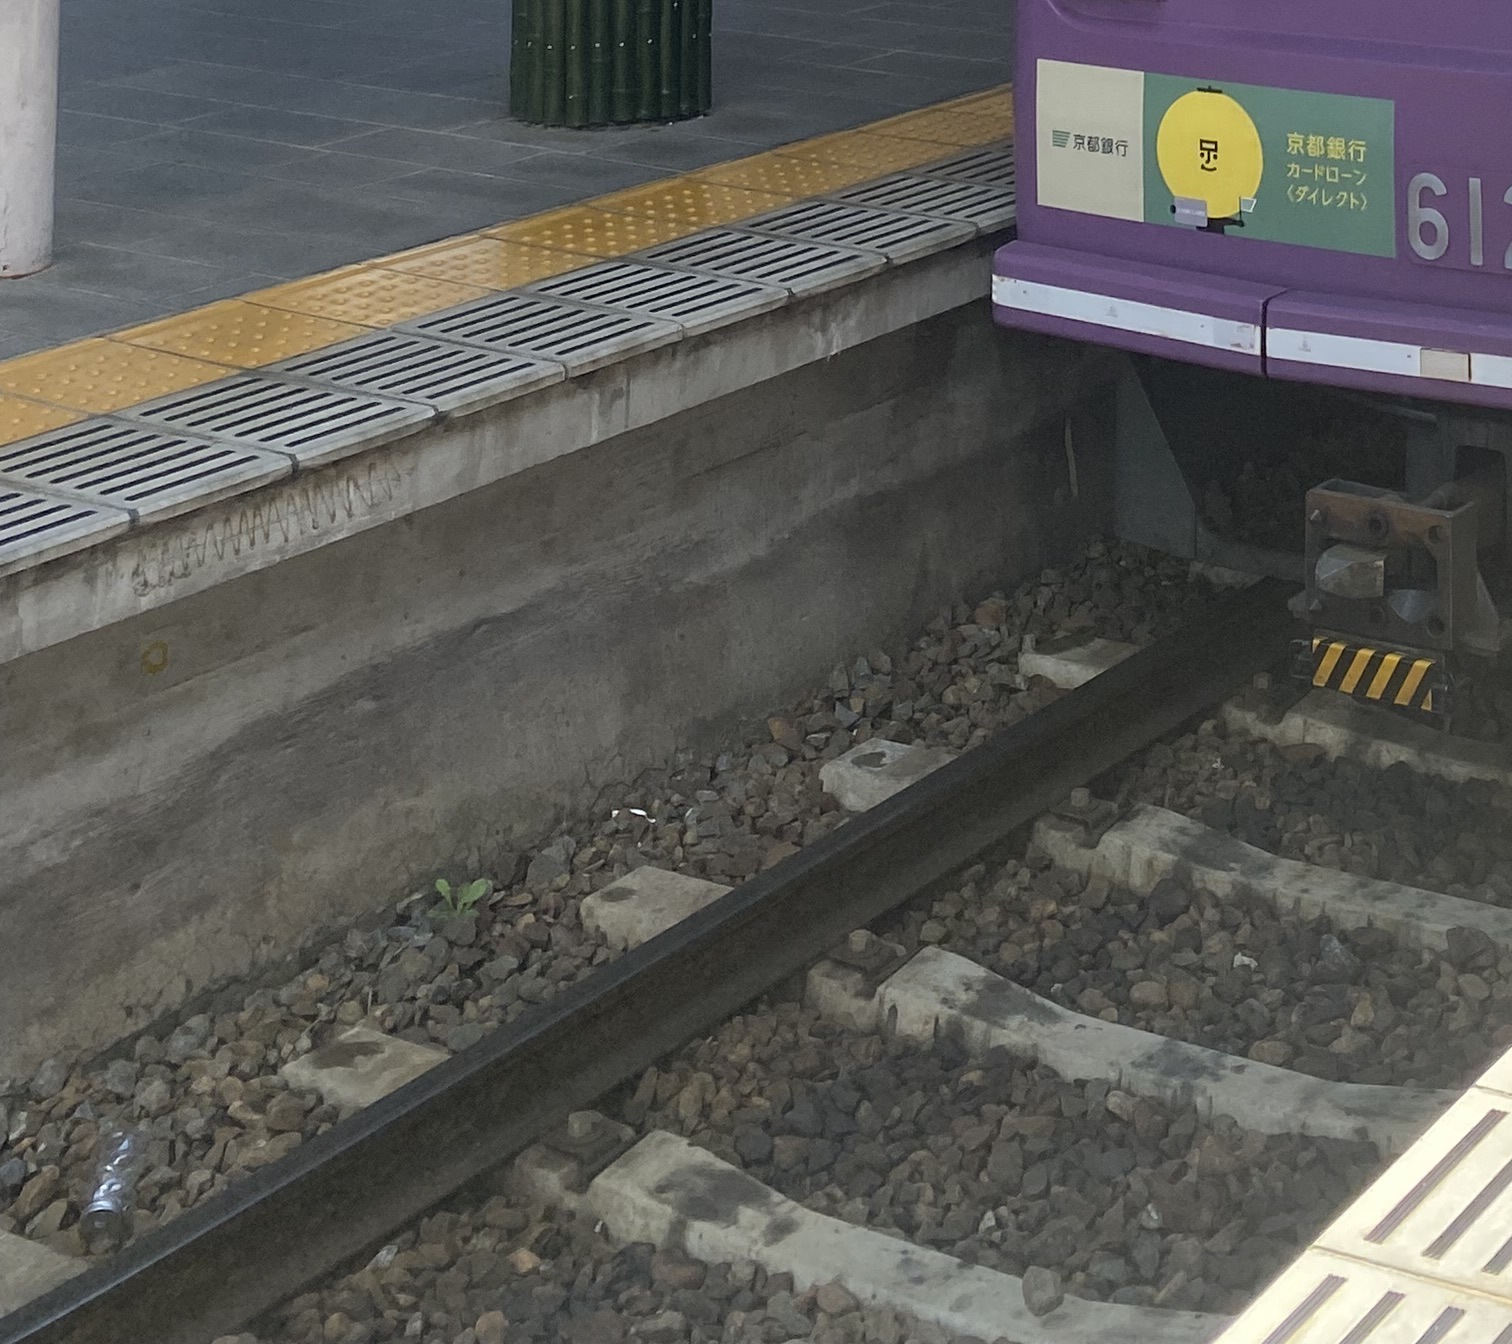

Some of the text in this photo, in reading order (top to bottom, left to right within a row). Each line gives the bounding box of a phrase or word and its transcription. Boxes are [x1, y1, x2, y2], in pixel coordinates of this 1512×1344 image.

[1073, 134, 1129, 158] 京都銀行
[1286, 131, 1367, 163] 京都銀行
[1286, 161, 1367, 186] カードローン
